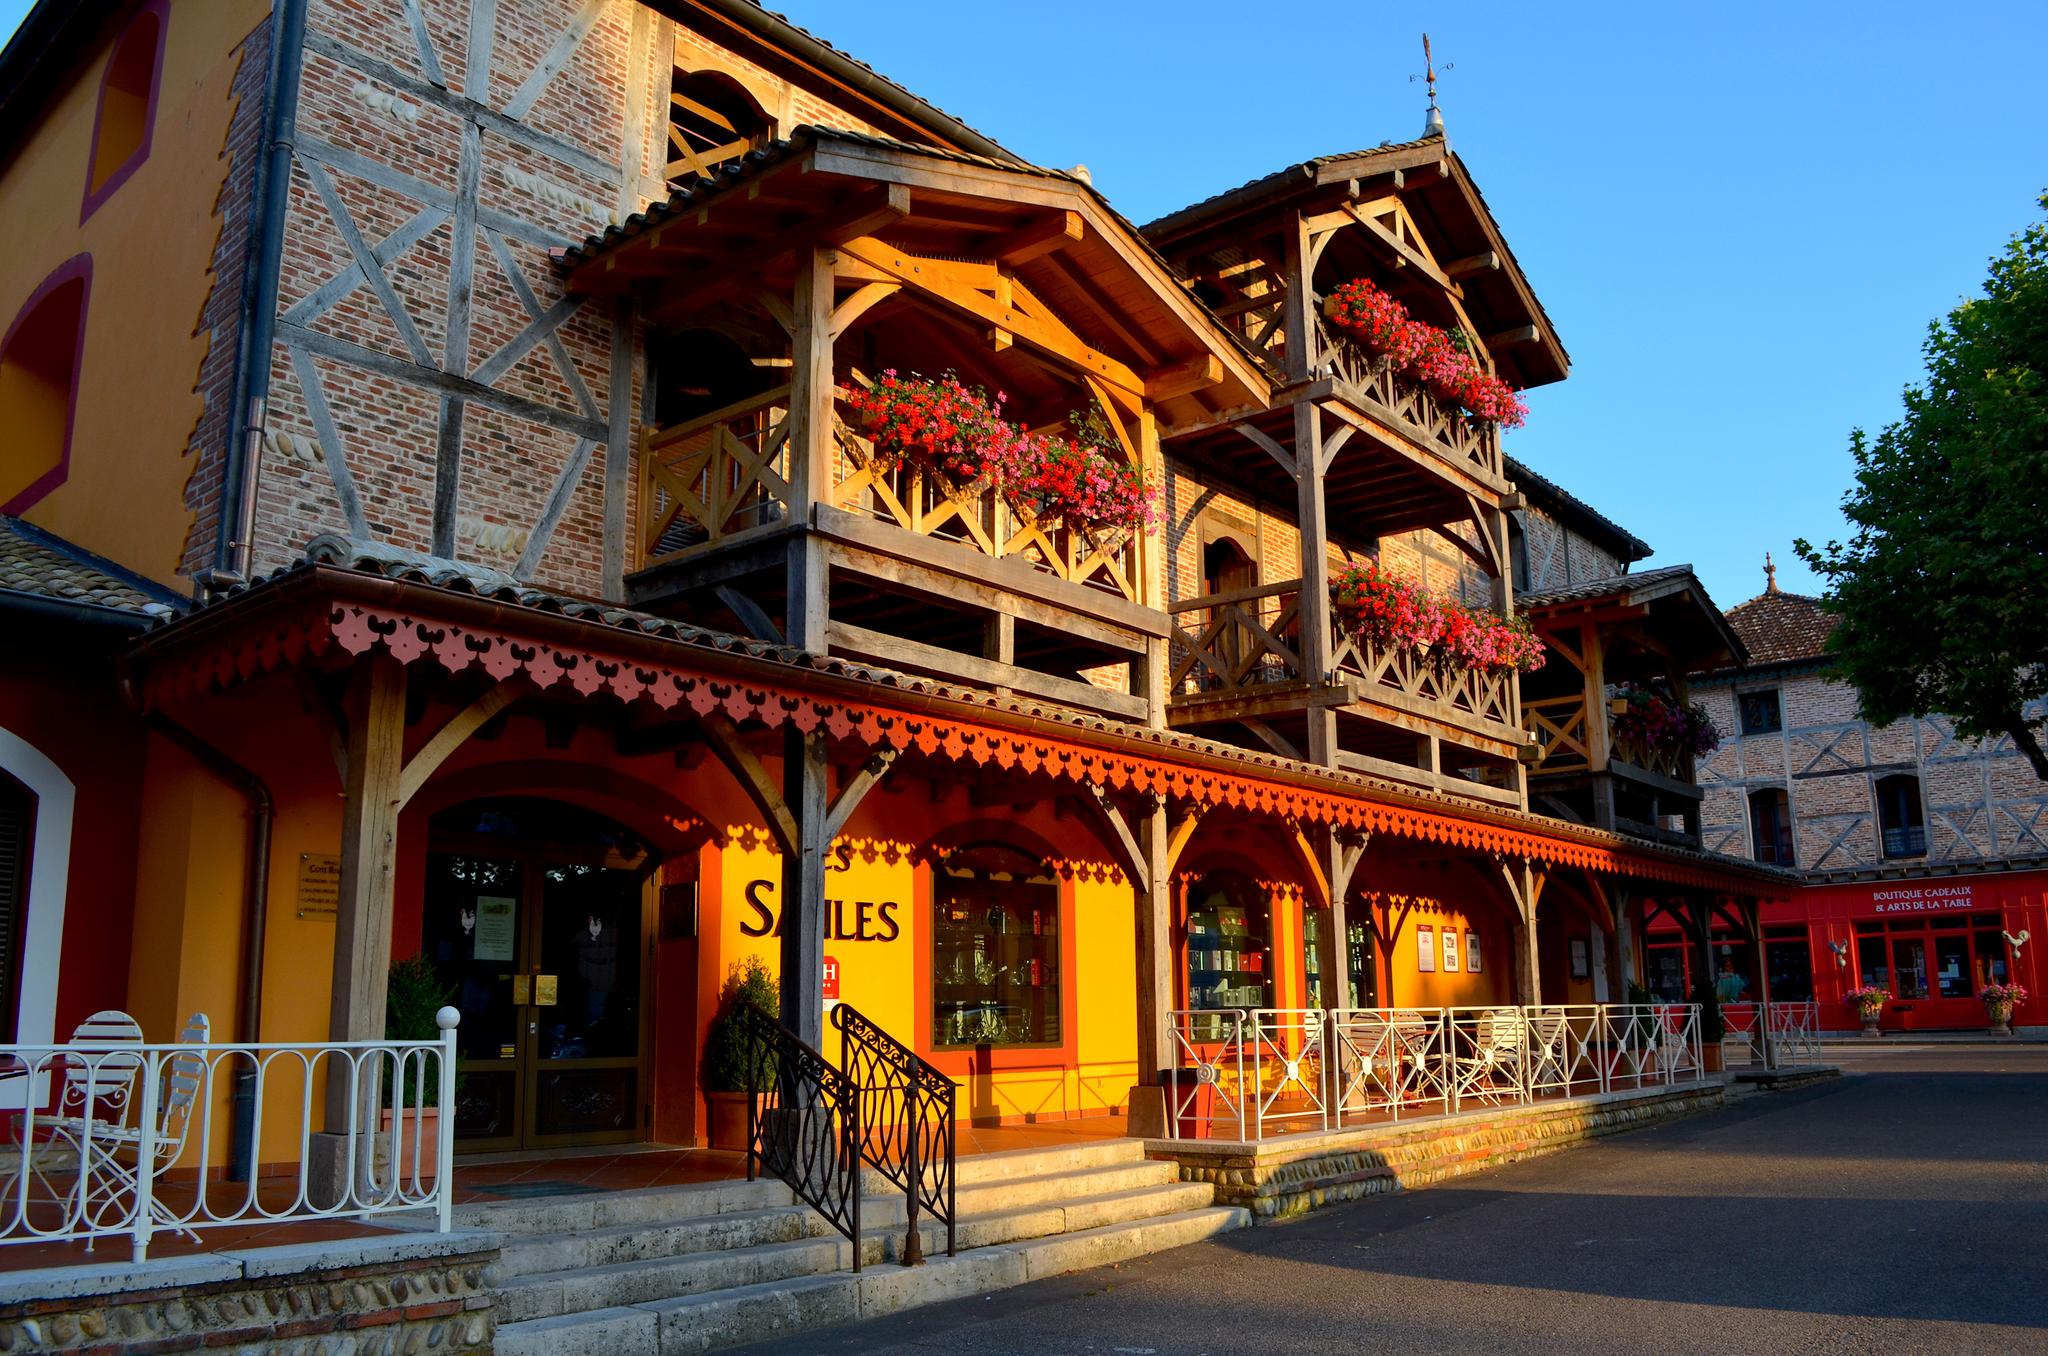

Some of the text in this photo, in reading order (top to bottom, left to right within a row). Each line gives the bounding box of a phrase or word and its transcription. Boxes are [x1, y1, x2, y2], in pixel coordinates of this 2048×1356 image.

[1873, 886, 1971, 900] BOUTIQUE CADEAUX
[740, 879, 900, 942] SLES
[1887, 902, 1911, 911] ARTS
[1913, 901, 1925, 910] DE
[1927, 900, 1940, 909] LA
[1942, 898, 1972, 908] TABLE
